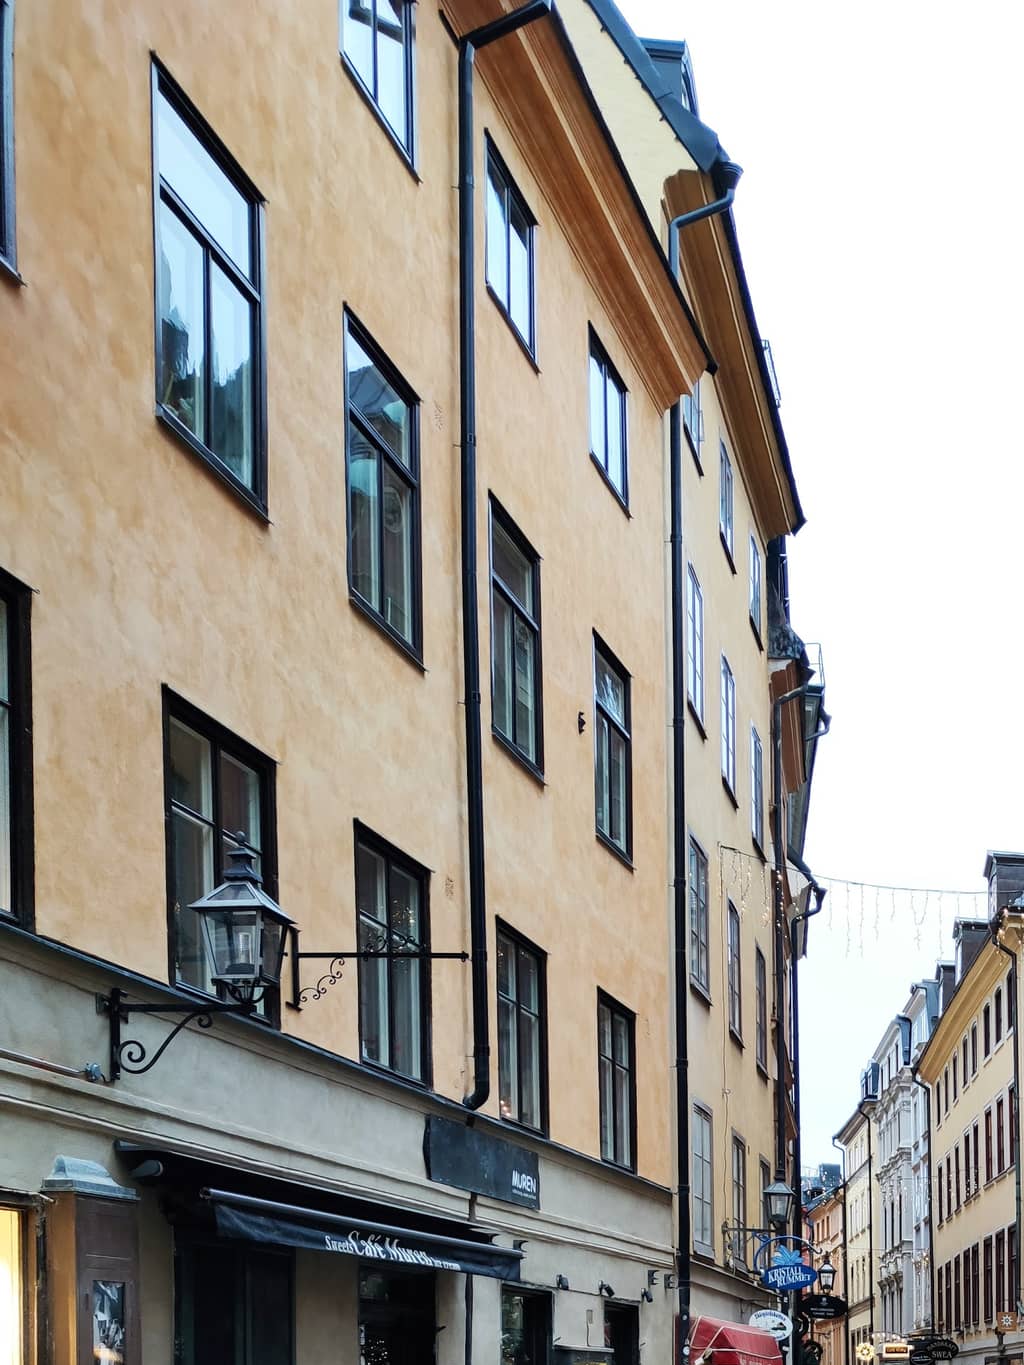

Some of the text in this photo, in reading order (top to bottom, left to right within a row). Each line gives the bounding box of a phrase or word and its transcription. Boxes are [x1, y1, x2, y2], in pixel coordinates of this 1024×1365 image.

[511, 1169, 537, 1193] MUREN
[325, 1235, 352, 1254] Sweets
[348, 1230, 386, 1259] Café
[385, 1237, 433, 1266] Muren
[767, 1266, 802, 1283] KRISTALL
[777, 1274, 811, 1287] RUMMET
[931, 1350, 953, 1359] SWEA
